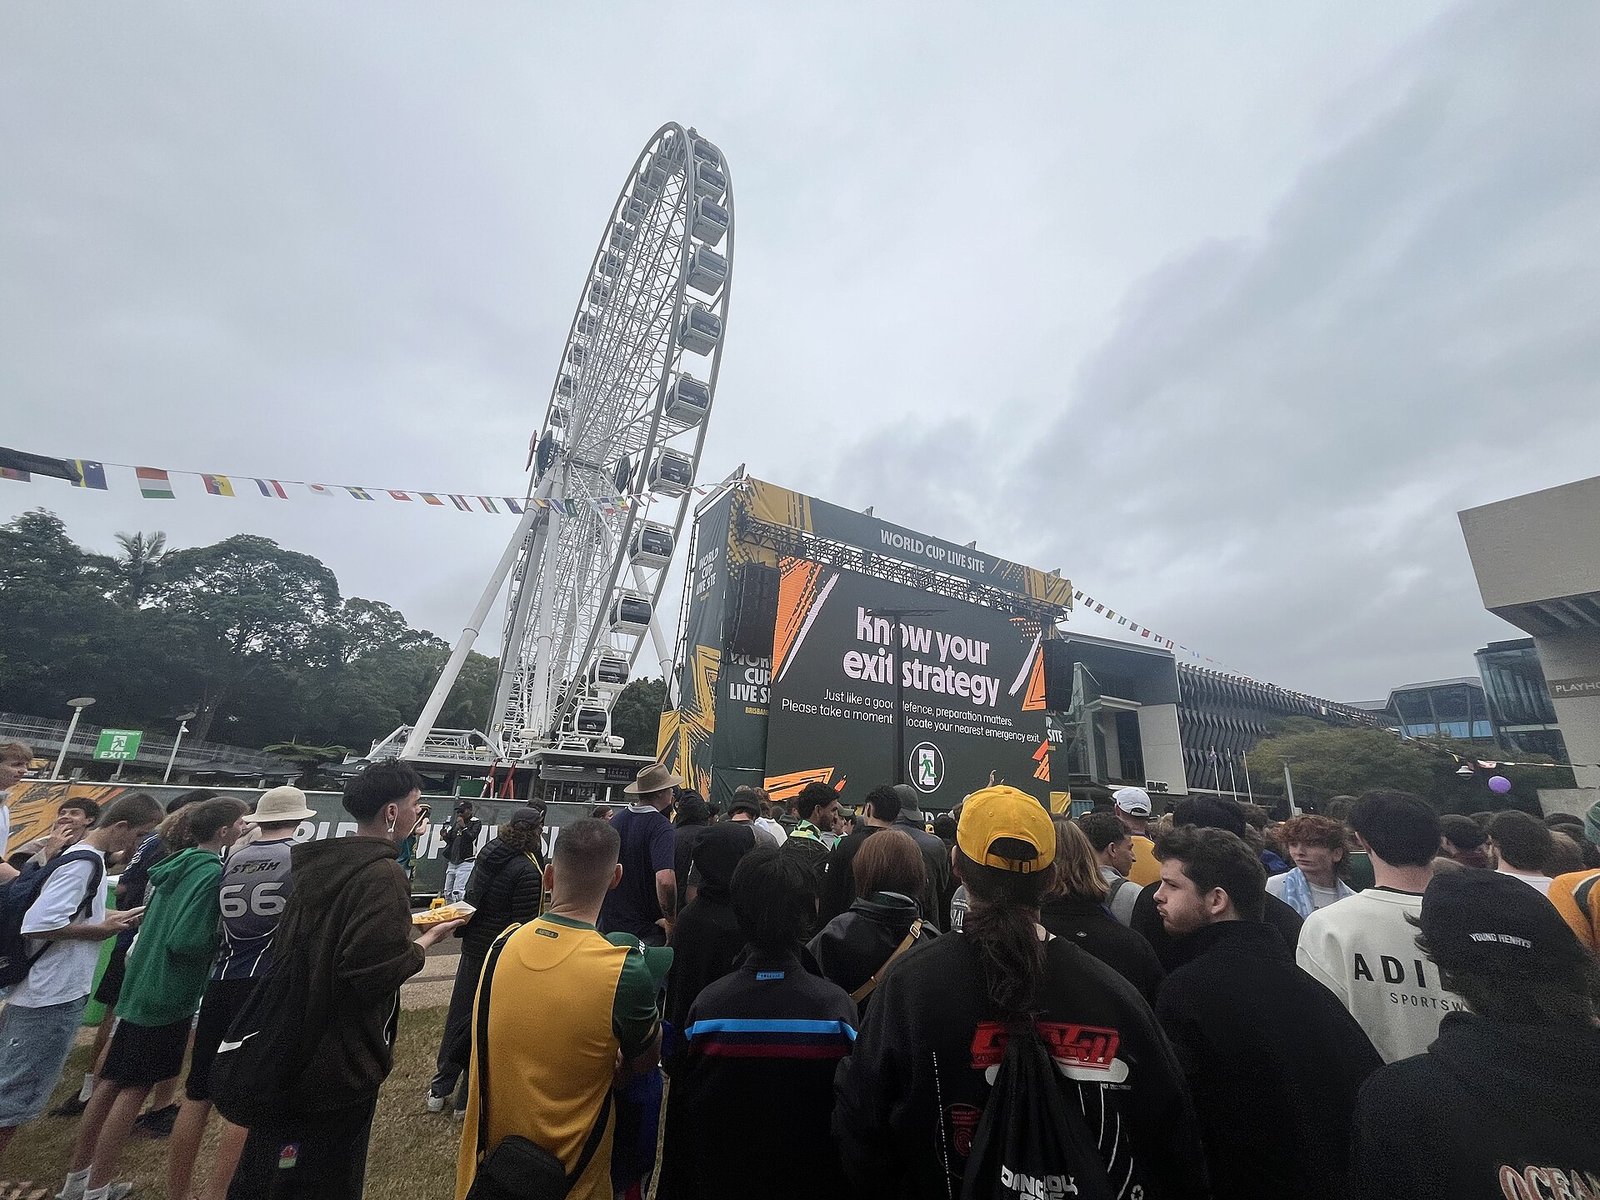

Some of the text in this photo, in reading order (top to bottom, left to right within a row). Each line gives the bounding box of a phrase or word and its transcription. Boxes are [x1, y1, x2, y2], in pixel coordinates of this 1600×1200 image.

[880, 529, 985, 573] WORLD CUP LIVE SITE
[857, 606, 990, 666] know your
[842, 647, 1000, 708] exit strategy
[729, 682, 772, 704] LIVE SI
[824, 689, 844, 703] Just
[846, 691, 863, 705] like
[864, 697, 871, 706] a
[781, 697, 894, 724] Please take a moment
[902, 700, 1013, 726] efence, preparation matters.
[905, 716, 933, 729] locate
[934, 722, 954, 732] your
[954, 724, 984, 736] nearest
[985, 728, 1026, 743] emergency
[1046, 728, 1063, 743] SITE
[100, 751, 131, 759] EXIT
[230, 861, 281, 874] STORM
[219, 881, 287, 918] 66
[1469, 932, 1531, 949] YOUNG HENRYS
[1354, 953, 1446, 990] ADI
